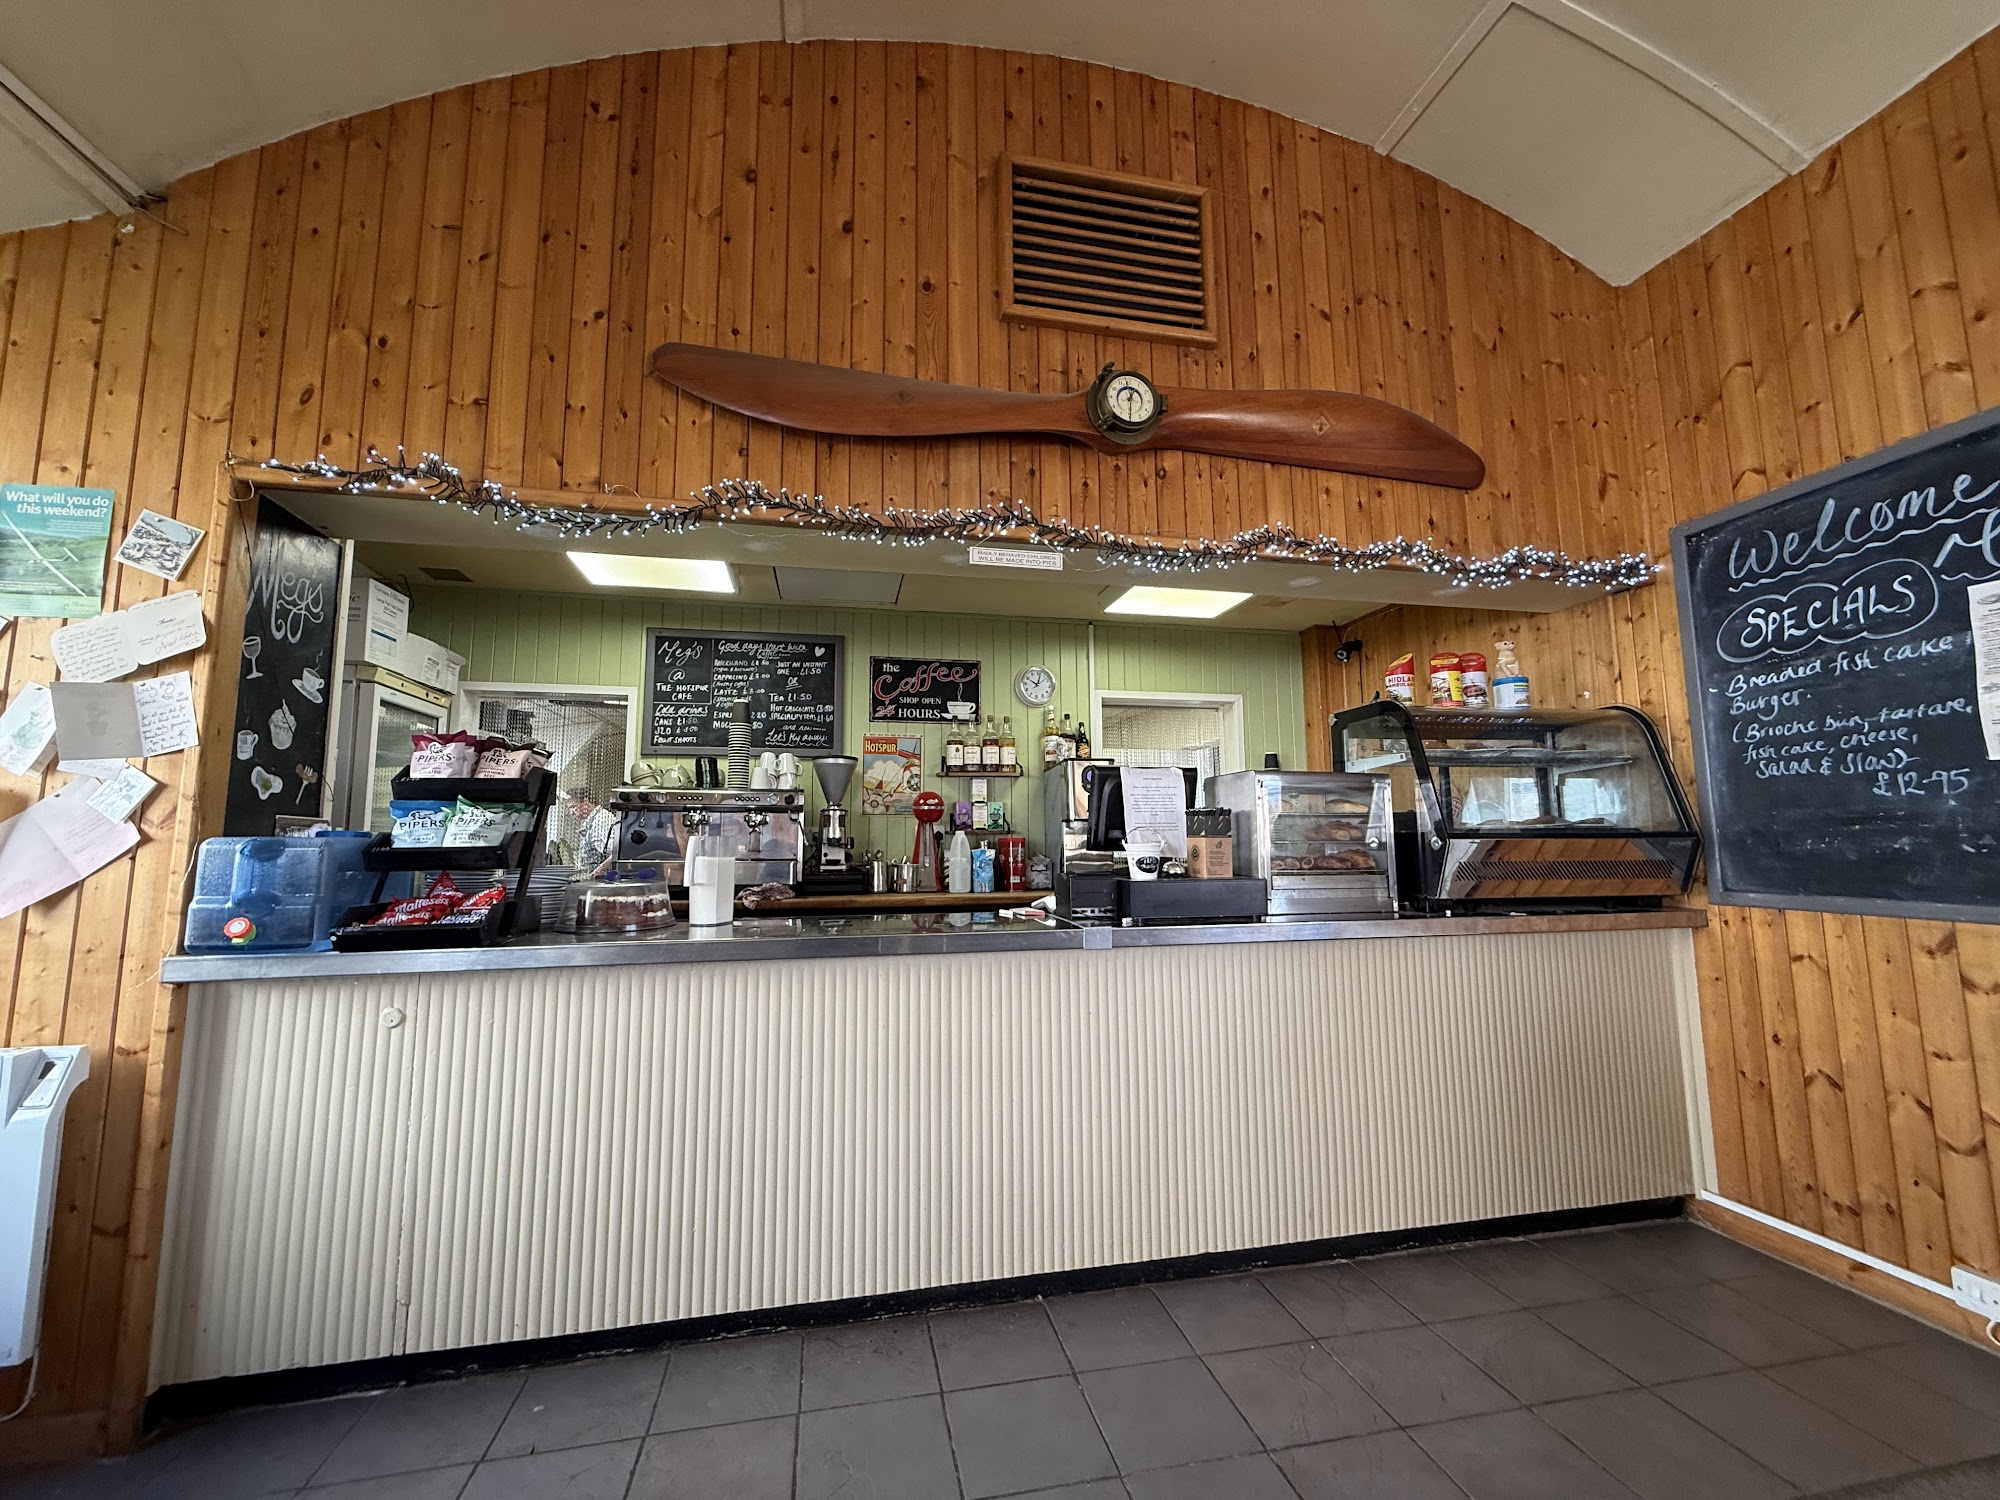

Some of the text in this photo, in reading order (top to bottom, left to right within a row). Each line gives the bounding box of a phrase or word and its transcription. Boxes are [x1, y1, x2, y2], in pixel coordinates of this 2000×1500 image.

[6, 490, 109, 507] What will you do
[16, 503, 108, 518] this weekend?
[1728, 473, 2000, 580] Welcome
[1740, 574, 1916, 648] SPECIALS
[657, 640, 704, 667] Meg's
[718, 640, 808, 656] Good days start with
[776, 660, 793, 668] JUST
[882, 662, 900, 673] the
[1725, 635, 1954, 697] Breaded fish cake
[668, 668, 686, 683] @
[776, 667, 790, 675] ONE
[656, 682, 709, 693] THE HOTSPUR
[787, 677, 799, 686] OR
[873, 662, 978, 701] Coffee
[714, 688, 739, 696] LATTE
[768, 693, 784, 702] TEA
[899, 696, 942, 705] SHOP OPEN
[1729, 688, 1812, 721] Burger.
[655, 704, 709, 715] Cold drinks
[770, 703, 784, 712] HOT
[898, 708, 941, 719] HOURS
[654, 717, 674, 726] CANS
[654, 726, 672, 735] J20
[765, 728, 786, 742] Let's
[1731, 718, 1819, 744] (Brioche
[1824, 714, 1870, 734] bun,
[865, 740, 897, 752] HOTSPUR
[1742, 726, 1918, 764] fish cake, cheese,
[417, 753, 453, 763] PIPERS
[480, 754, 516, 766] PIPERS
[1820, 758, 1833, 776] &
[400, 819, 445, 831] PIPERS
[455, 817, 496, 827] PIPERS
[395, 897, 450, 913] Maltesers
